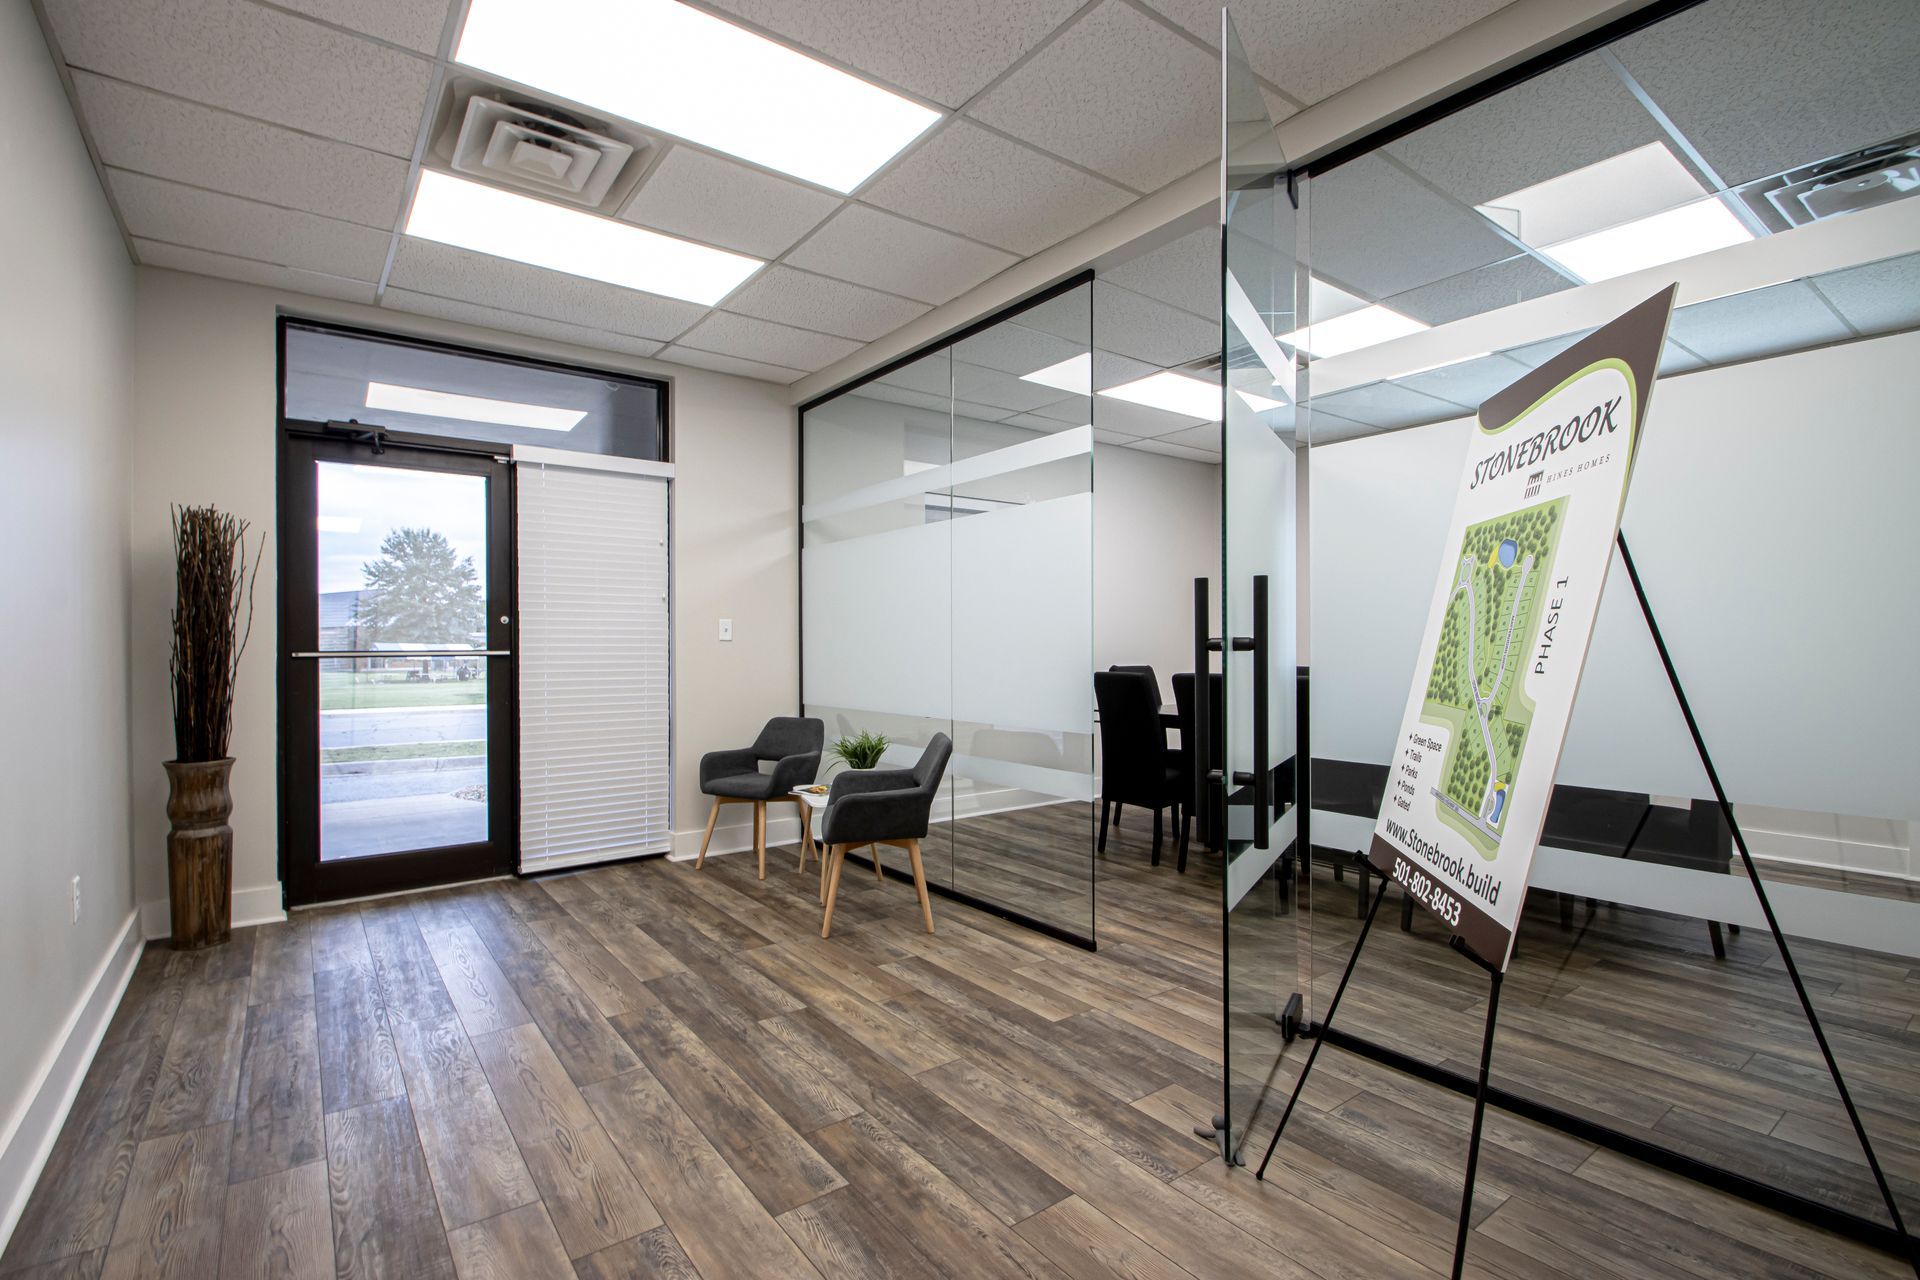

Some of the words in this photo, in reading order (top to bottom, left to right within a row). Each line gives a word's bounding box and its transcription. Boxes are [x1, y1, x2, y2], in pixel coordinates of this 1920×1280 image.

[1470, 396, 1621, 490] STONEBROOK
[1547, 467, 1573, 483] HINES
[1577, 454, 1610, 472] HOMES
[1534, 598, 1563, 674] PHASE
[1557, 576, 1569, 588] 1
[1413, 733, 1426, 747] Green
[1426, 738, 1442, 752] Space
[1410, 749, 1422, 763] Trails
[1405, 765, 1418, 779] Parks
[1401, 780, 1415, 796] Ponds
[1397, 796, 1411, 812] Gated
[1386, 818, 1501, 907] www.Stonebrook.build
[1393, 857, 1462, 927] 501-802-8453
